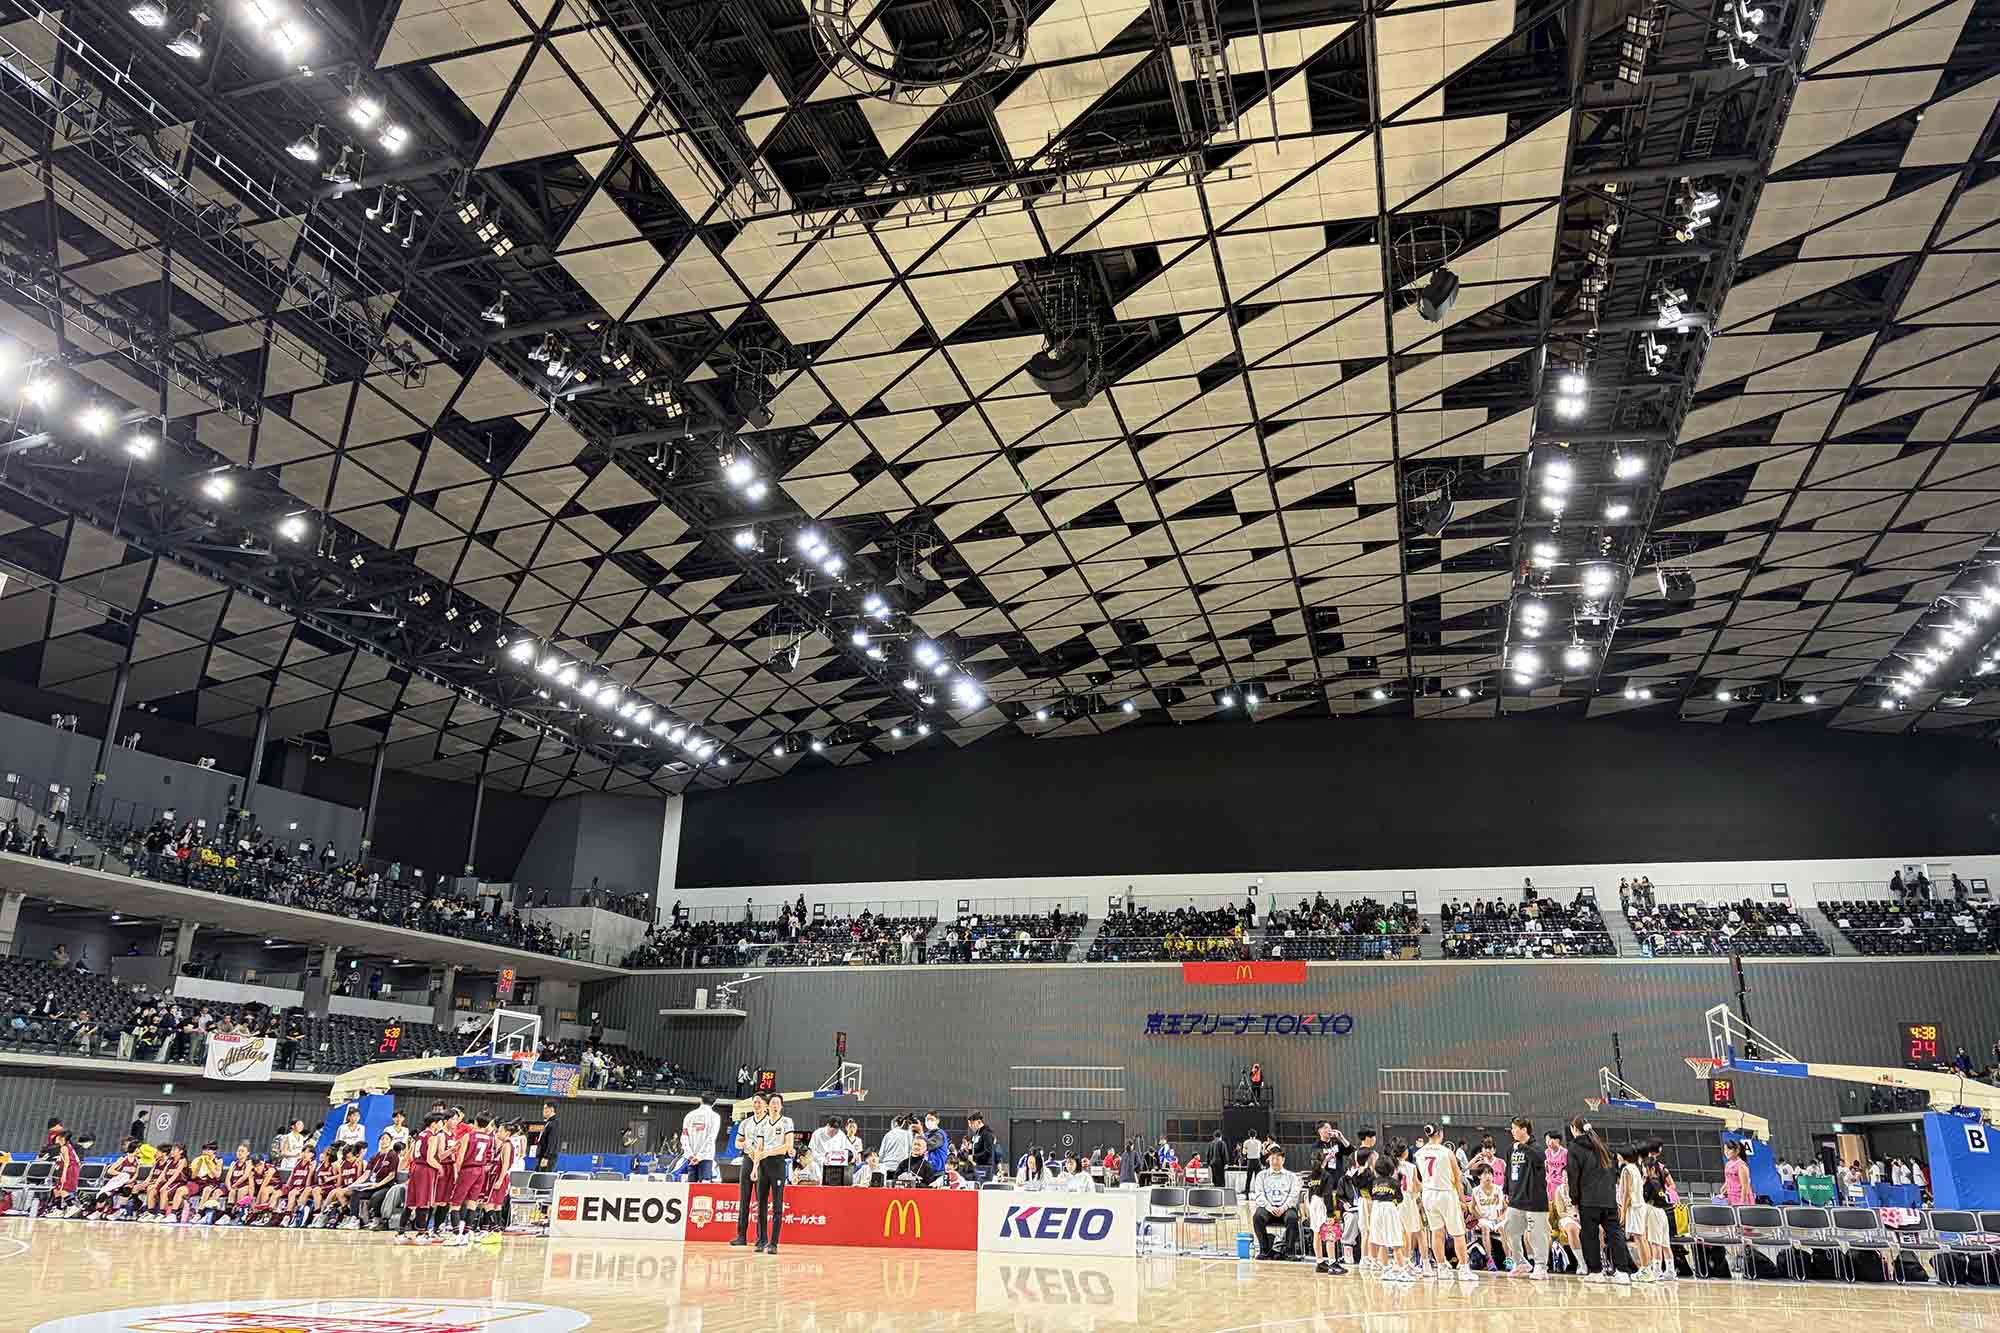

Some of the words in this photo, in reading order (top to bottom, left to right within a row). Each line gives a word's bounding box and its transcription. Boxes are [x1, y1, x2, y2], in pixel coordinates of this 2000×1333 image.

[1144, 1013, 1258, 1036] 京王アリーナ
[1262, 1013, 1354, 1036] TOKYO
[1911, 1026, 1936, 1040] 4:38
[380, 1038, 397, 1053] 24
[1912, 1040, 1936, 1058] 24
[1715, 1089, 1729, 1100] 24
[1968, 1129, 1985, 1149] B
[475, 1141, 488, 1162] 7
[1424, 1156, 1437, 1177] 7
[581, 1196, 682, 1224] ENEOS
[1000, 1206, 1114, 1241] KEIO
